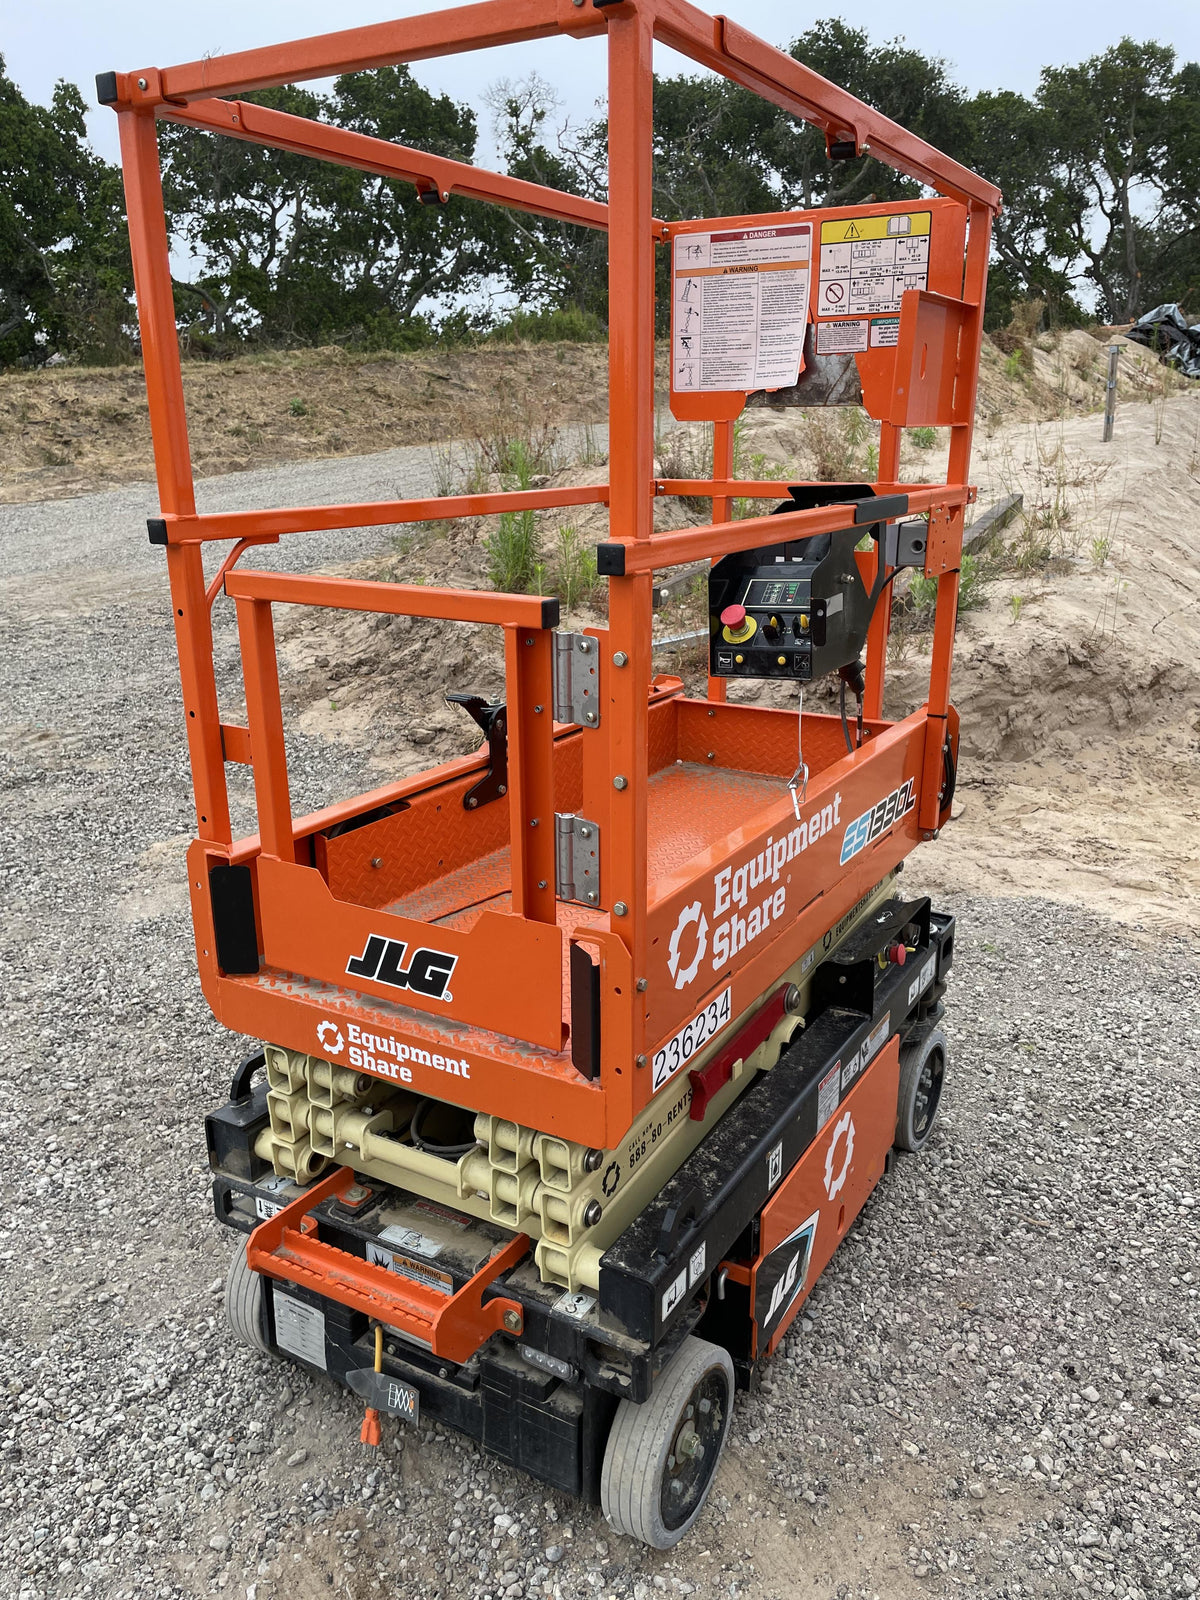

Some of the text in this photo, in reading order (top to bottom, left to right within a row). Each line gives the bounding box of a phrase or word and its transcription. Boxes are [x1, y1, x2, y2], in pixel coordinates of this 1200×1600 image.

[749, 230, 776, 238] DANGER
[713, 791, 842, 919] Equipment
[712, 885, 785, 971] Share
[345, 933, 458, 1000] JLG
[347, 1023, 470, 1079] Equipment
[349, 1046, 412, 1083] Share
[654, 989, 730, 1089] 236234
[628, 1122, 652, 1152] CALL NOW
[629, 1088, 693, 1168] 888-80-RENTS
[410, 1262, 441, 1280] WARNING
[763, 1250, 800, 1328] JLG
